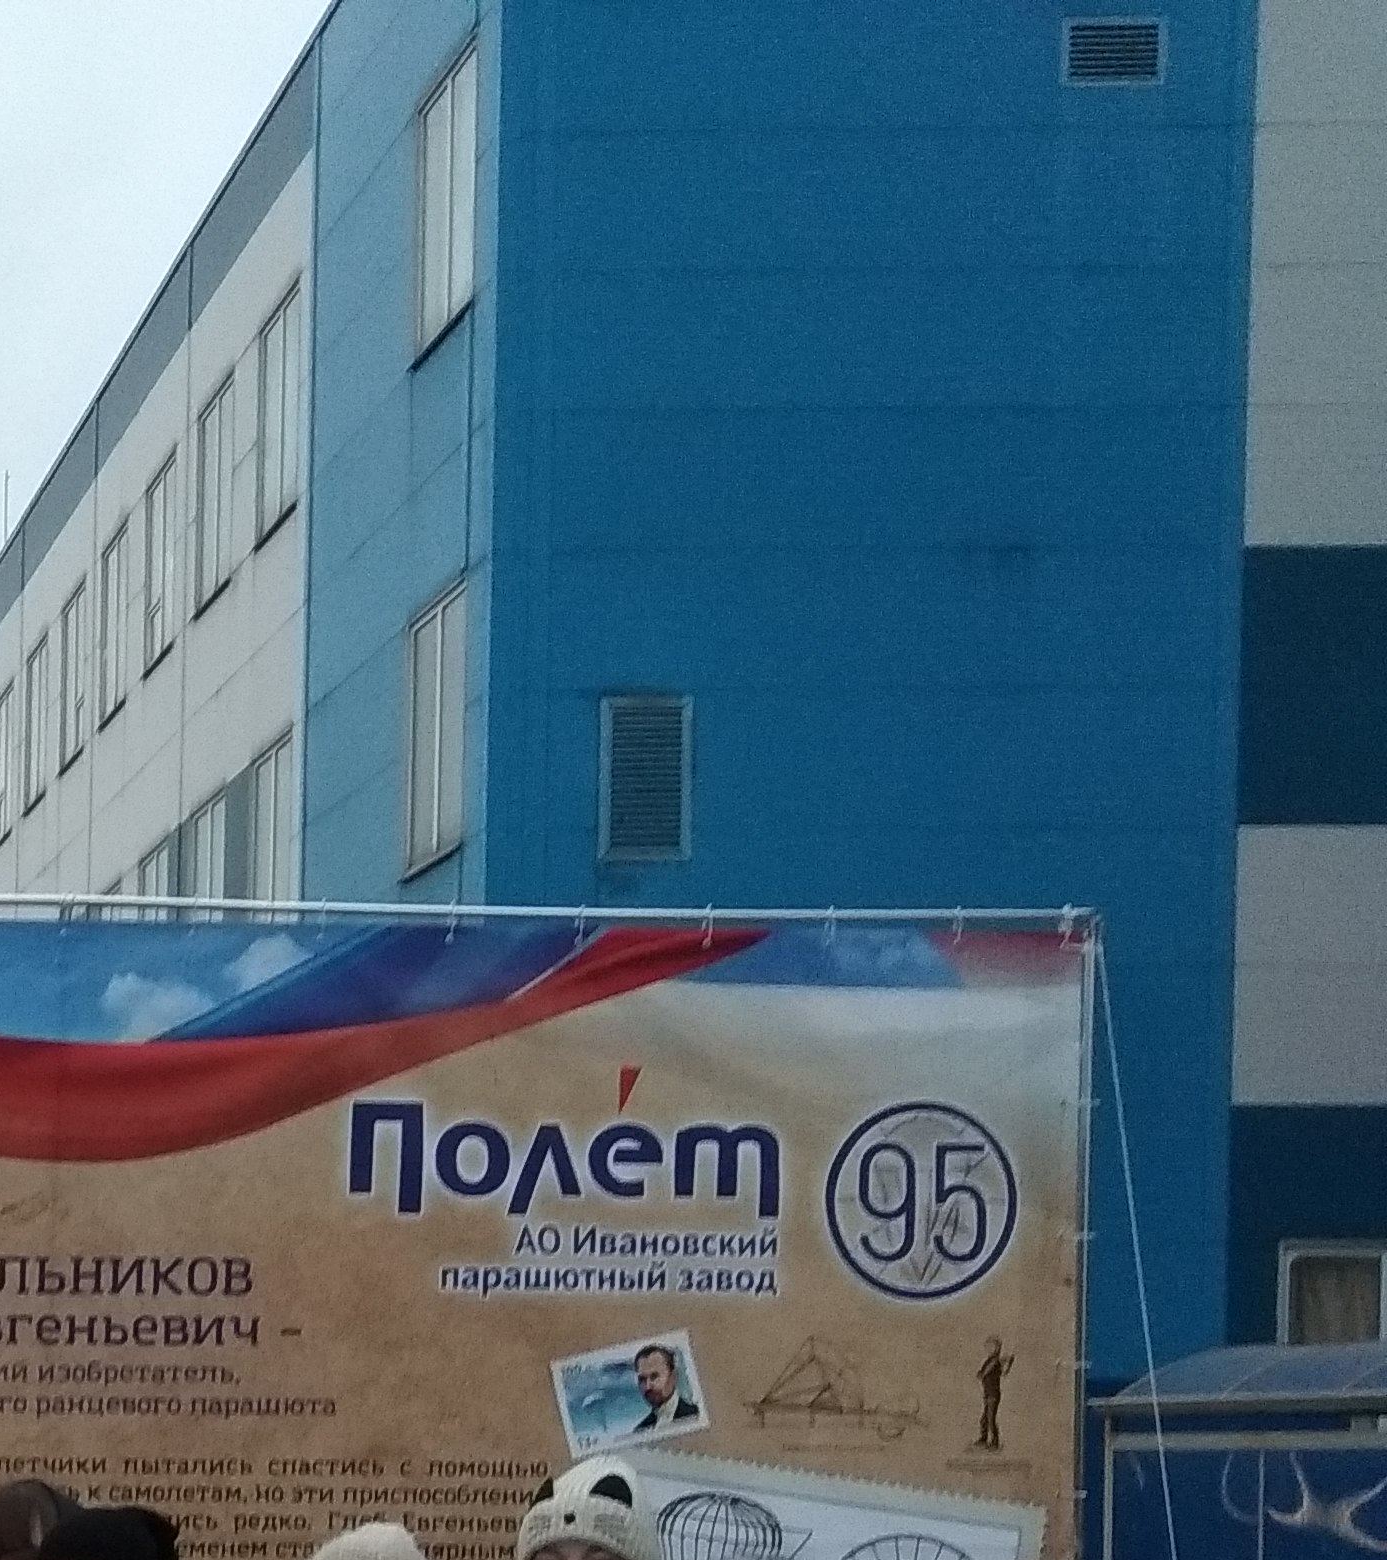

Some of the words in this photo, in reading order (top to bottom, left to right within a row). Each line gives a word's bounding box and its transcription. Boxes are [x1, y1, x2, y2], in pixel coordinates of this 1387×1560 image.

[857, 1141, 987, 1264] 95
[513, 1223, 561, 1255] АО
[572, 1223, 778, 1257] Ивановский
[440, 1259, 668, 1298] парашютный
[677, 1267, 778, 1297] завод
[38, 1359, 241, 1386] изобретатель,
[36, 1396, 181, 1420] ранцевого
[191, 1396, 337, 1420] парашюта
[124, 1456, 253, 1476] пытались
[268, 1457, 384, 1477] спастись
[400, 1461, 411, 1477] с
[430, 1458, 549, 1480] помощью
[255, 1485, 284, 1503] но
[293, 1485, 335, 1504] эти
[343, 1484, 534, 1508] приспособлени
